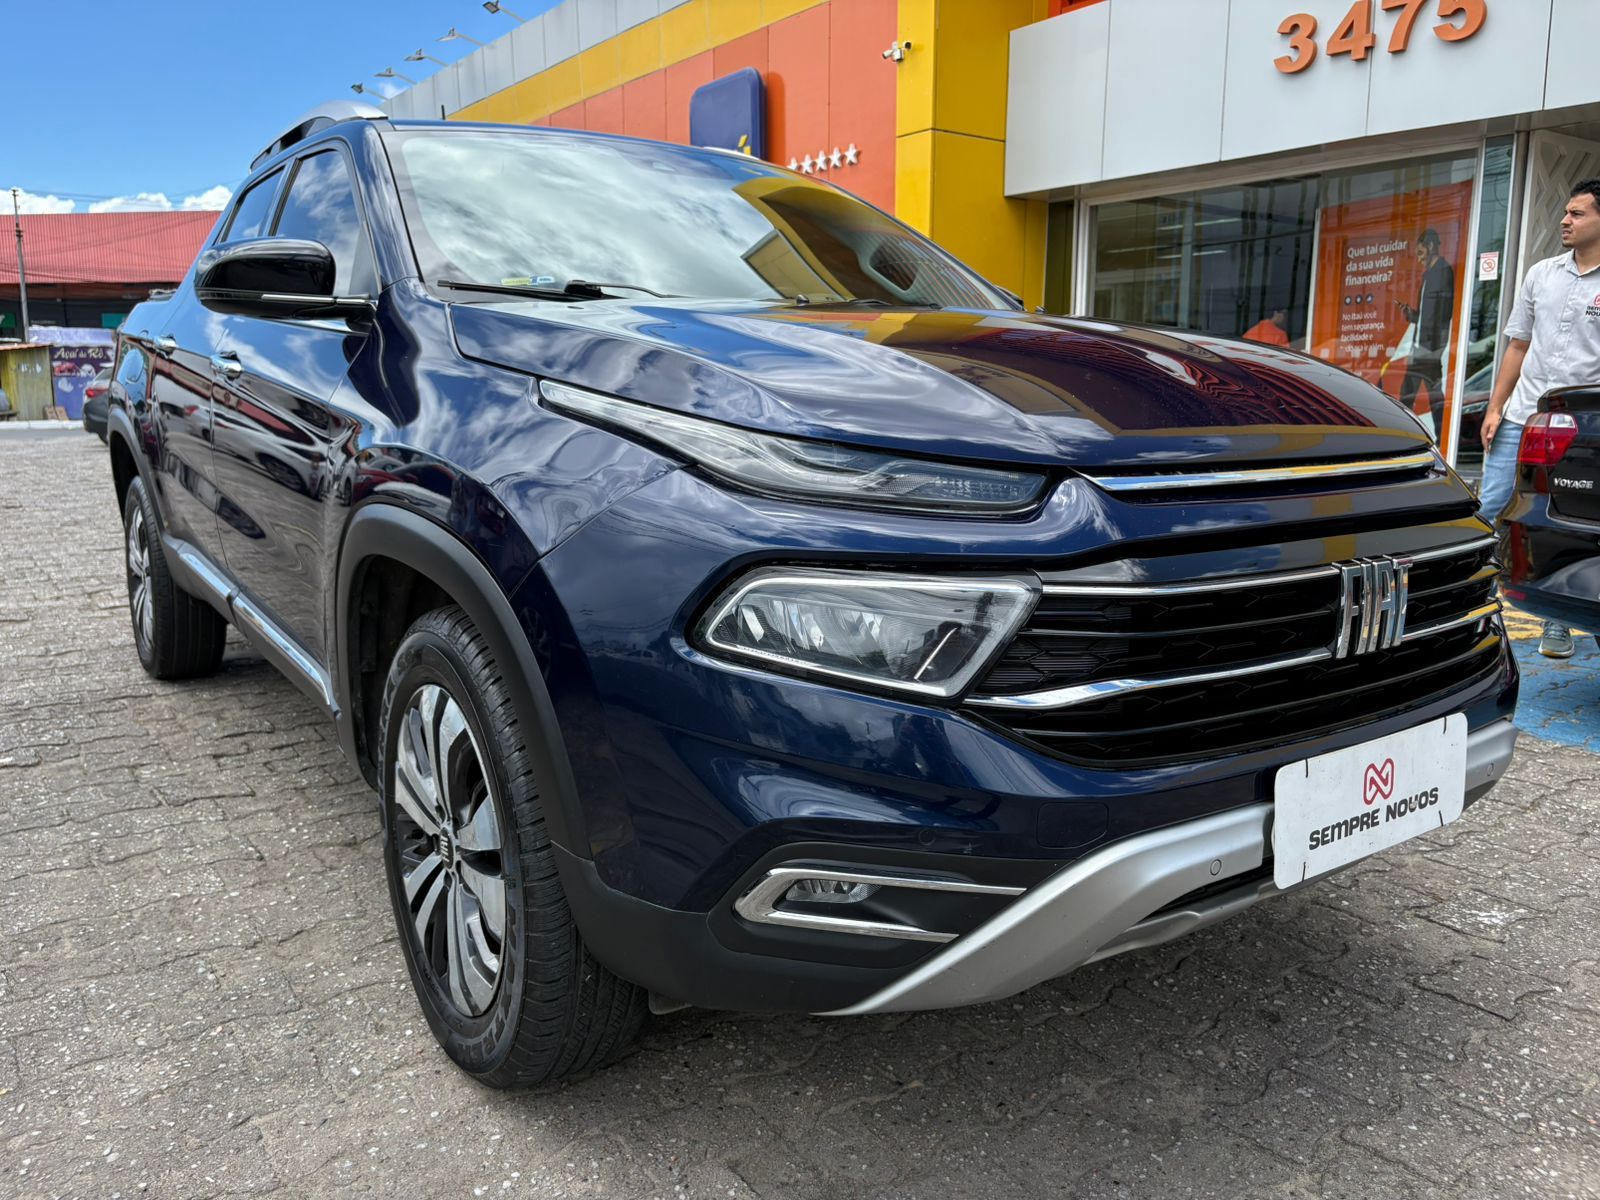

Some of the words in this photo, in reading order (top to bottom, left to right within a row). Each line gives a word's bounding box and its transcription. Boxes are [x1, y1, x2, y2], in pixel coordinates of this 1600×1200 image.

[1273, 0, 1488, 74] 3475
[1347, 247, 1365, 259] Que
[1366, 243, 1378, 255] tal
[1379, 240, 1408, 253] cuidar
[1346, 261, 1357, 272] da
[1358, 260, 1374, 271] sua
[1375, 256, 1394, 268] vida
[1345, 270, 1393, 286] financeira?
[1342, 313, 1350, 321] No
[1341, 333, 1369, 342] facilidade
[1554, 477, 1594, 489] VOYAGE
[1335, 556, 1412, 659] FIAT
[1309, 807, 1380, 850] SEMPRE
